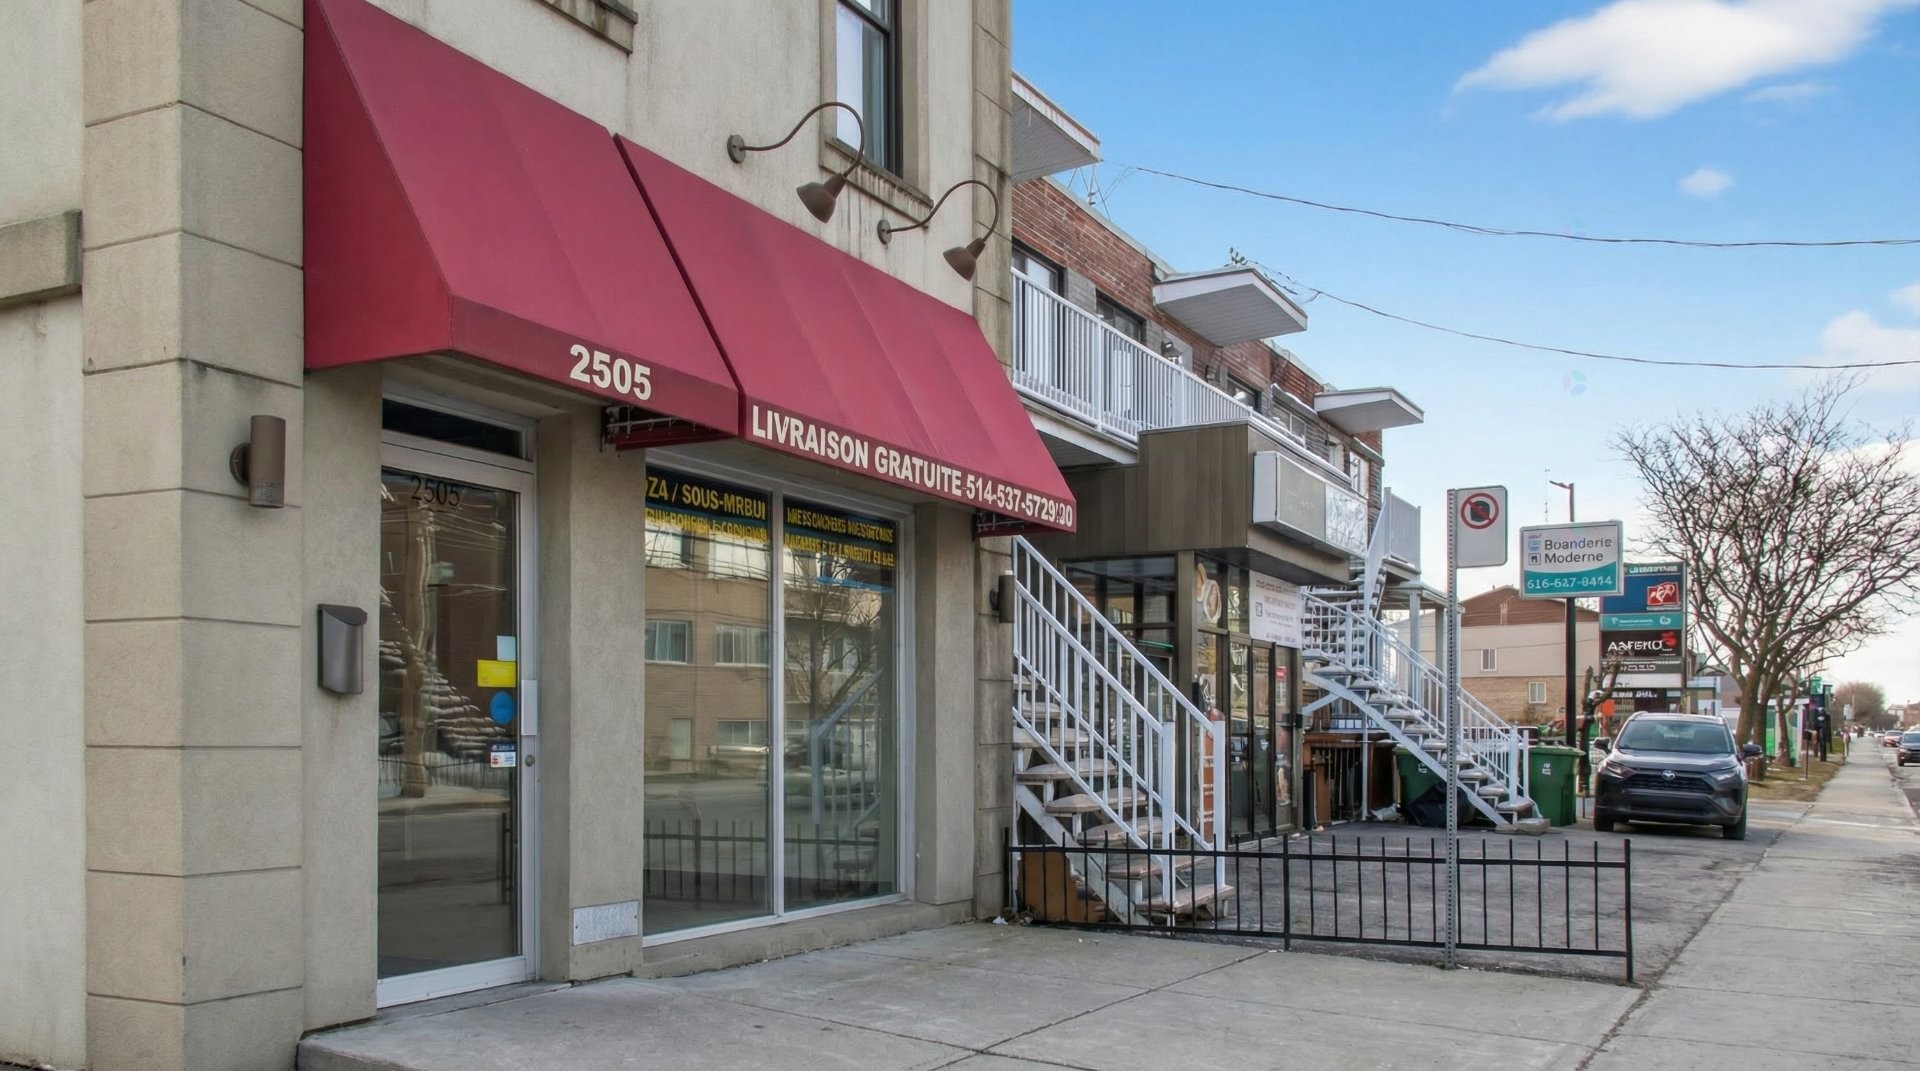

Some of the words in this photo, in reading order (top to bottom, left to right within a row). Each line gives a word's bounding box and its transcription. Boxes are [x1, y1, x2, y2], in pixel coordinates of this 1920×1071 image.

[570, 344, 652, 400] 2505
[752, 405, 869, 469] LIVRAISON
[874, 446, 962, 496] GRATUITE
[411, 475, 460, 507] 2505
[1544, 552, 1604, 564] Moderne
